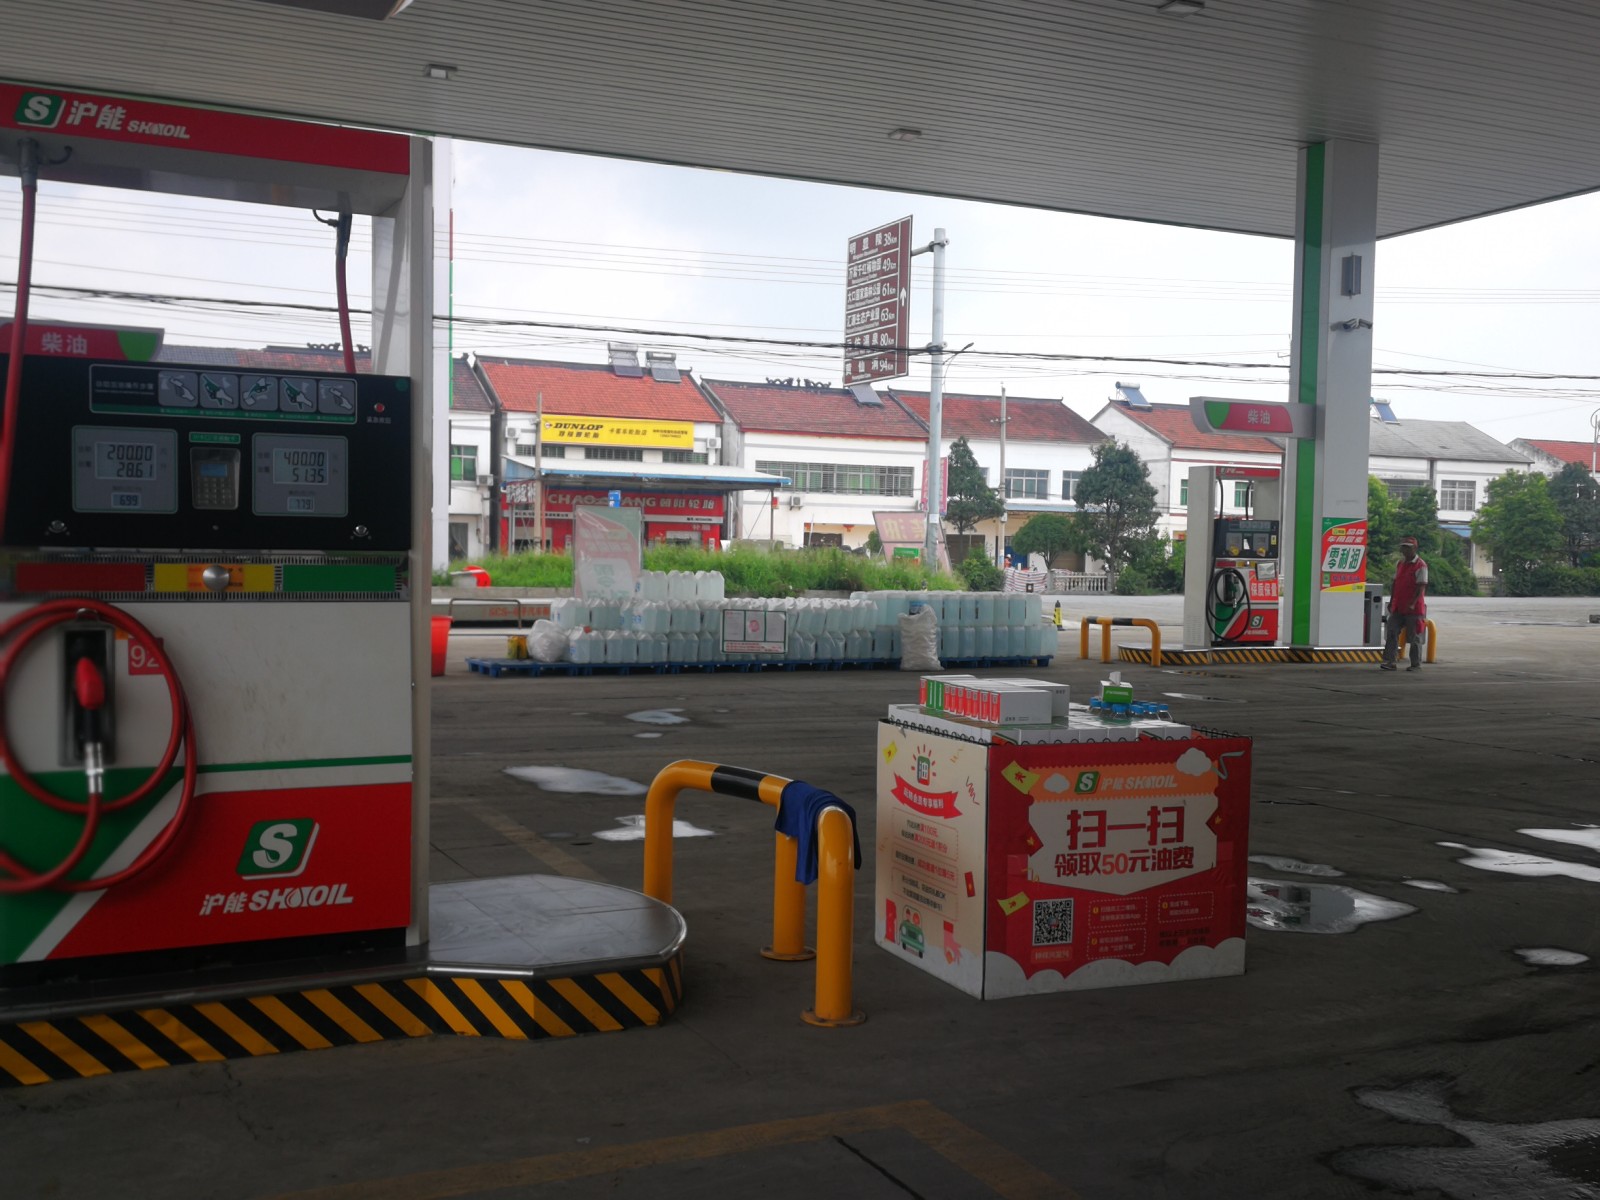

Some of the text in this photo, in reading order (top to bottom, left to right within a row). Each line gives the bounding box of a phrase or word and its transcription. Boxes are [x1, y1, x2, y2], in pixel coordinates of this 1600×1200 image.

[66, 100, 127, 131] 沪能
[41, 331, 88, 355] 柴油
[554, 422, 604, 431] DUNLOP
[1247, 408, 1271, 425] 柴油
[1328, 547, 1361, 569] 零利润
[1066, 805, 1185, 850] 扫一扫
[1055, 846, 1194, 877] 领取50元油费
[199, 891, 248, 916] 沪能
